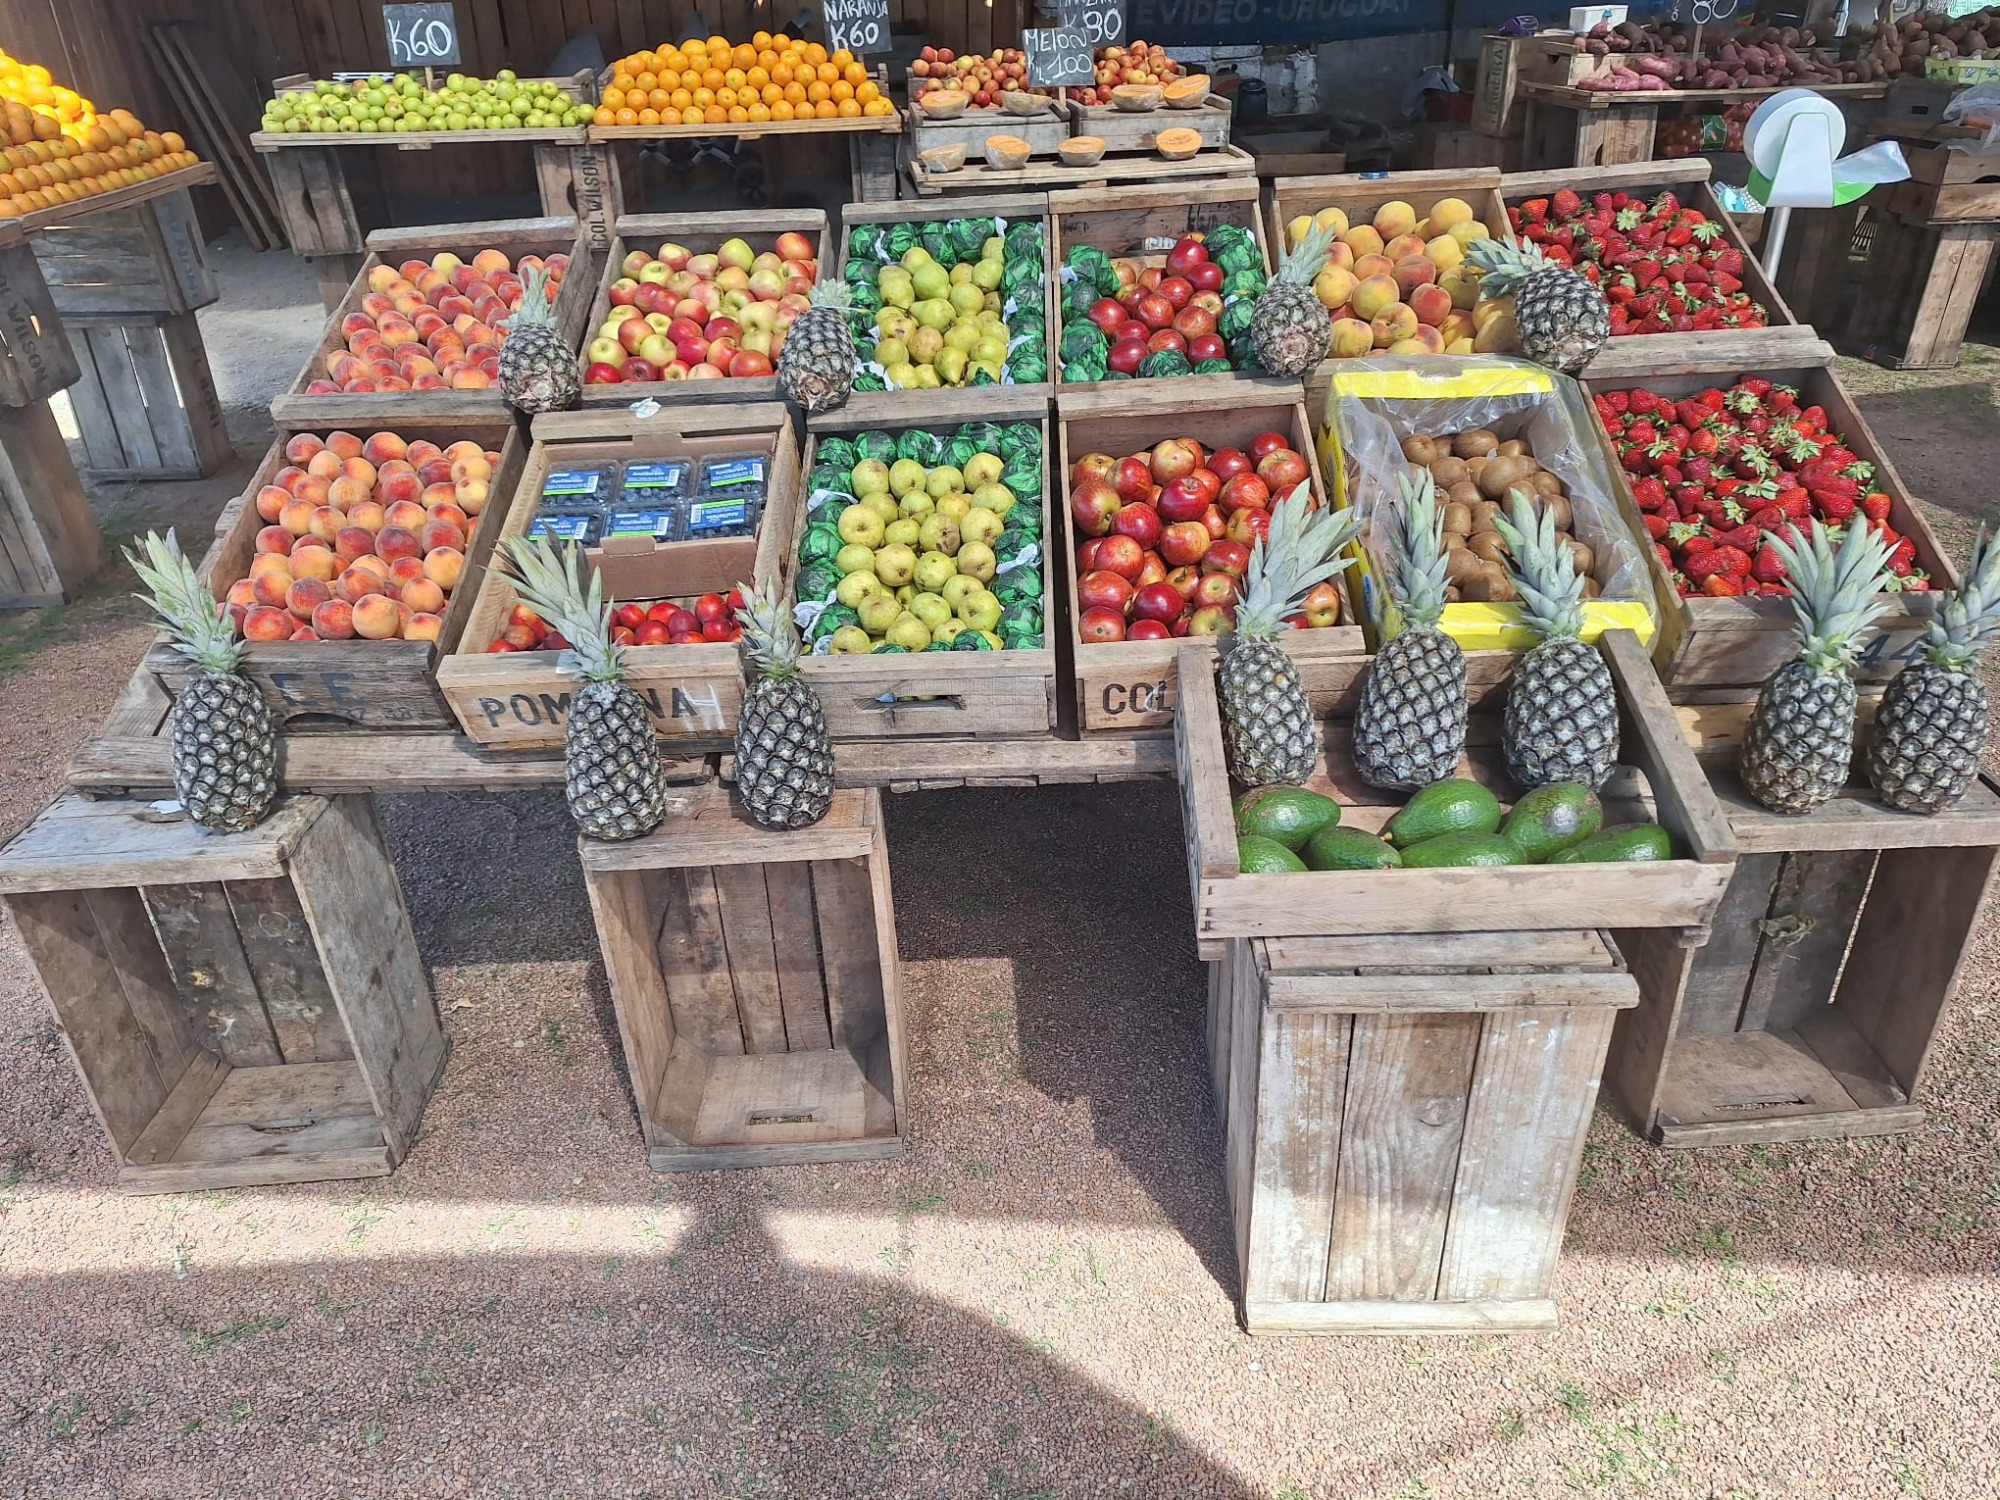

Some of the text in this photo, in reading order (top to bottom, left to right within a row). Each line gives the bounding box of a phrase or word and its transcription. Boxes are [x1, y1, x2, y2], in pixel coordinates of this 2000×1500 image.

[823, 0, 889, 22] NARANJA
[387, 18, 452, 61] K60
[830, 20, 879, 53] K60
[1024, 27, 1087, 52] MELON
[1047, 53, 1092, 79] 100
[7, 301, 49, 383] WILSON
[478, 687, 697, 728] POMNA
[1102, 680, 1175, 715] COL
